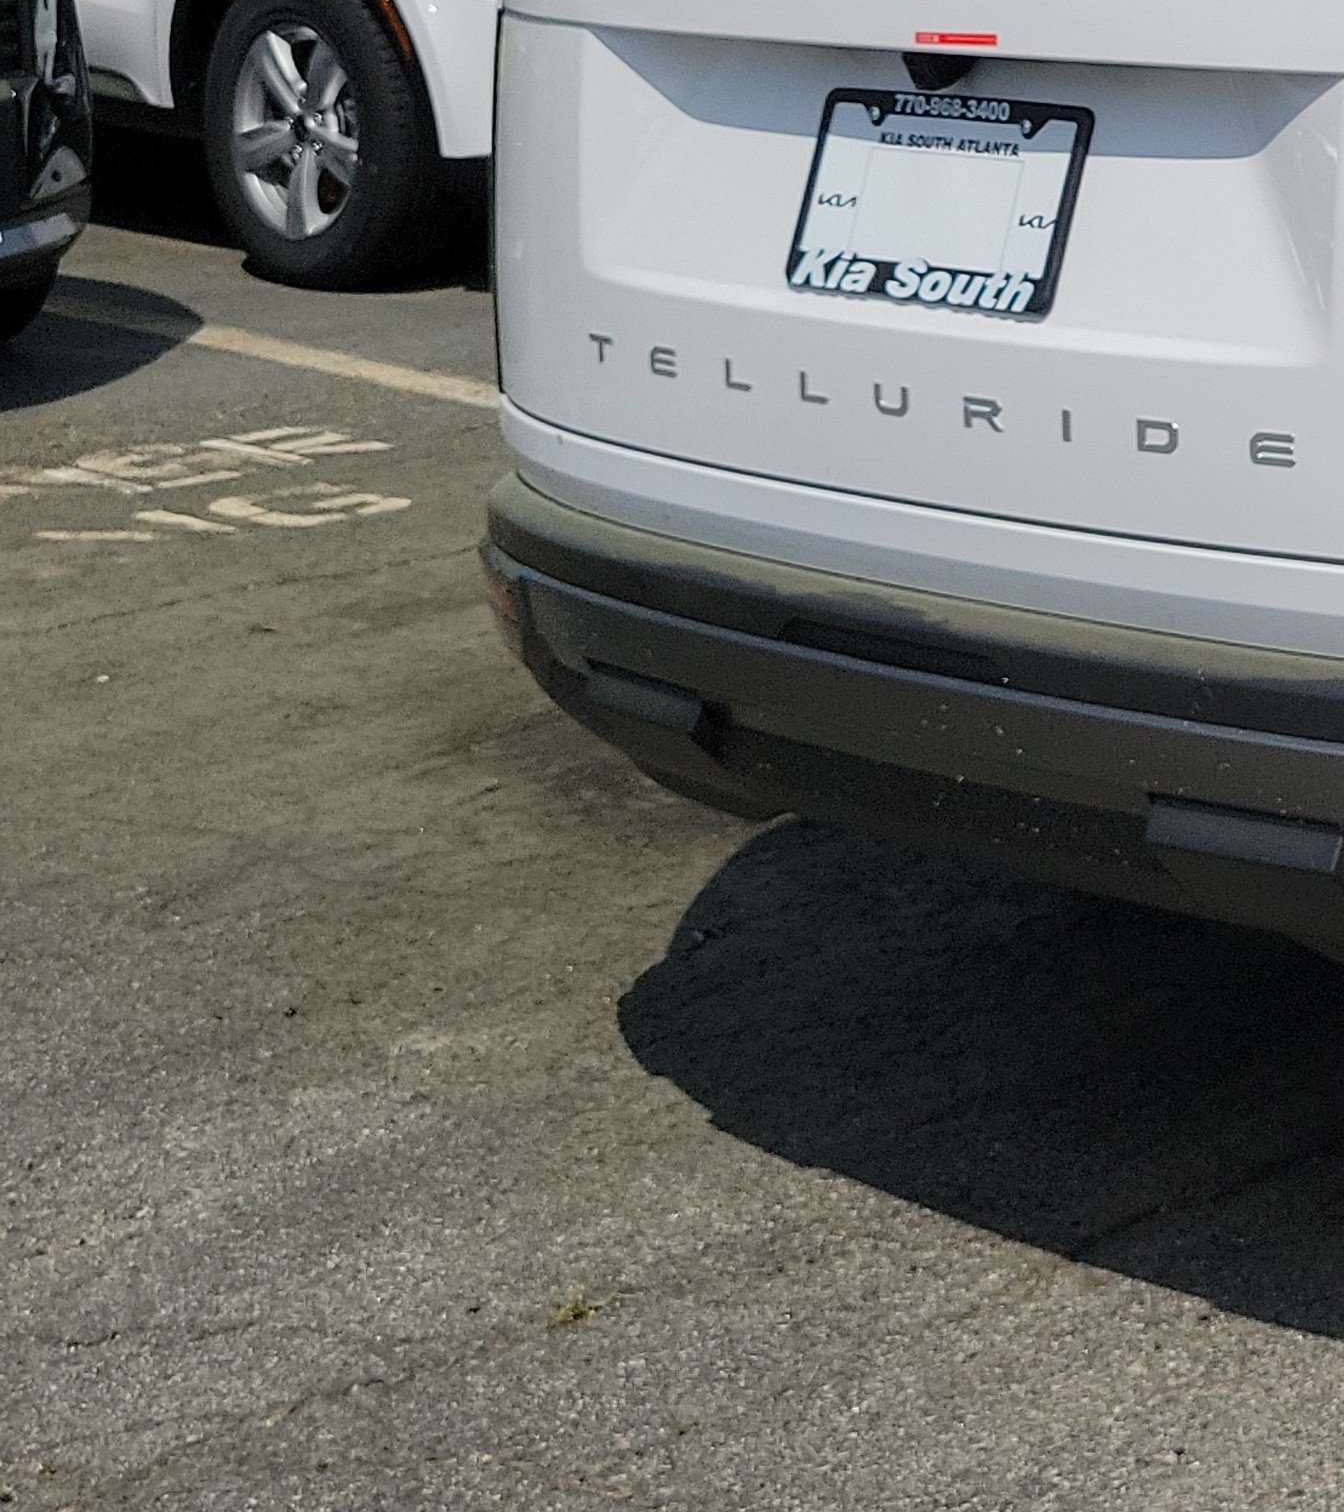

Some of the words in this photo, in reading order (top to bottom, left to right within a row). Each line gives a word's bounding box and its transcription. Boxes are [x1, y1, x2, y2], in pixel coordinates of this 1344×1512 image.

[894, 94, 1011, 121] 770-968-3400
[878, 132, 903, 146] KIA
[906, 134, 954, 151] SOUTH
[957, 138, 1019, 156] ATLANTA
[789, 248, 877, 294] Kia
[884, 256, 1036, 312] South
[588, 333, 1298, 468] TELLURIDE
